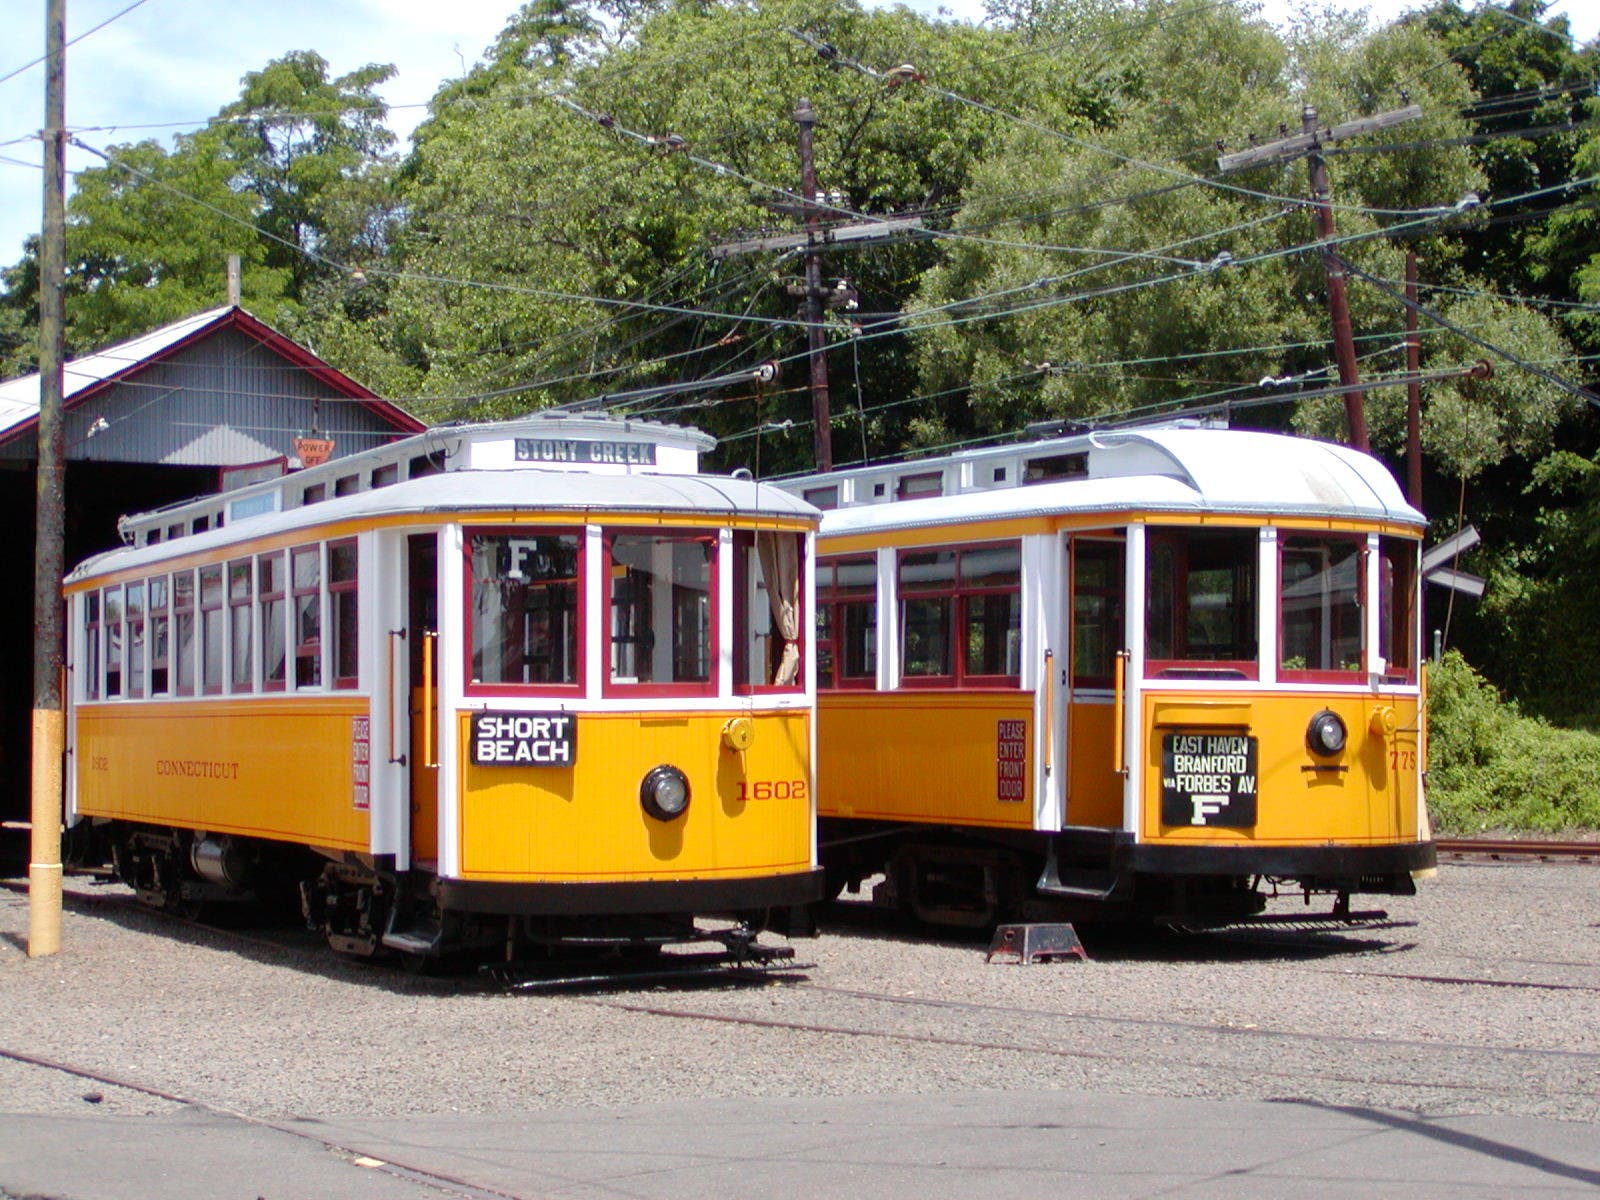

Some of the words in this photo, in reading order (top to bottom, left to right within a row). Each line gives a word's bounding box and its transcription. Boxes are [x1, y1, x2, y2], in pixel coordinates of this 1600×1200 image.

[517, 439, 577, 461] STONY
[590, 442, 651, 464] CREEK
[508, 540, 537, 578] F
[478, 717, 569, 738] SHORT
[999, 722, 1025, 739] PLEASE
[477, 740, 569, 762] BEACH
[999, 742, 1024, 759] ENTER
[1173, 736, 1203, 753] EAST
[1207, 736, 1248, 755] HAVEN
[156, 759, 239, 779] CONNECTICUT
[999, 761, 1024, 778] FRONT
[1173, 755, 1247, 773] BRANFORD
[1390, 751, 1416, 770] 775
[736, 780, 806, 801] 1602
[1000, 780, 1023, 797] DOOR
[1163, 778, 1176, 788] VIA
[1176, 774, 1232, 793] FORBES
[1237, 775, 1257, 794] AV.
[1191, 795, 1230, 825] F
